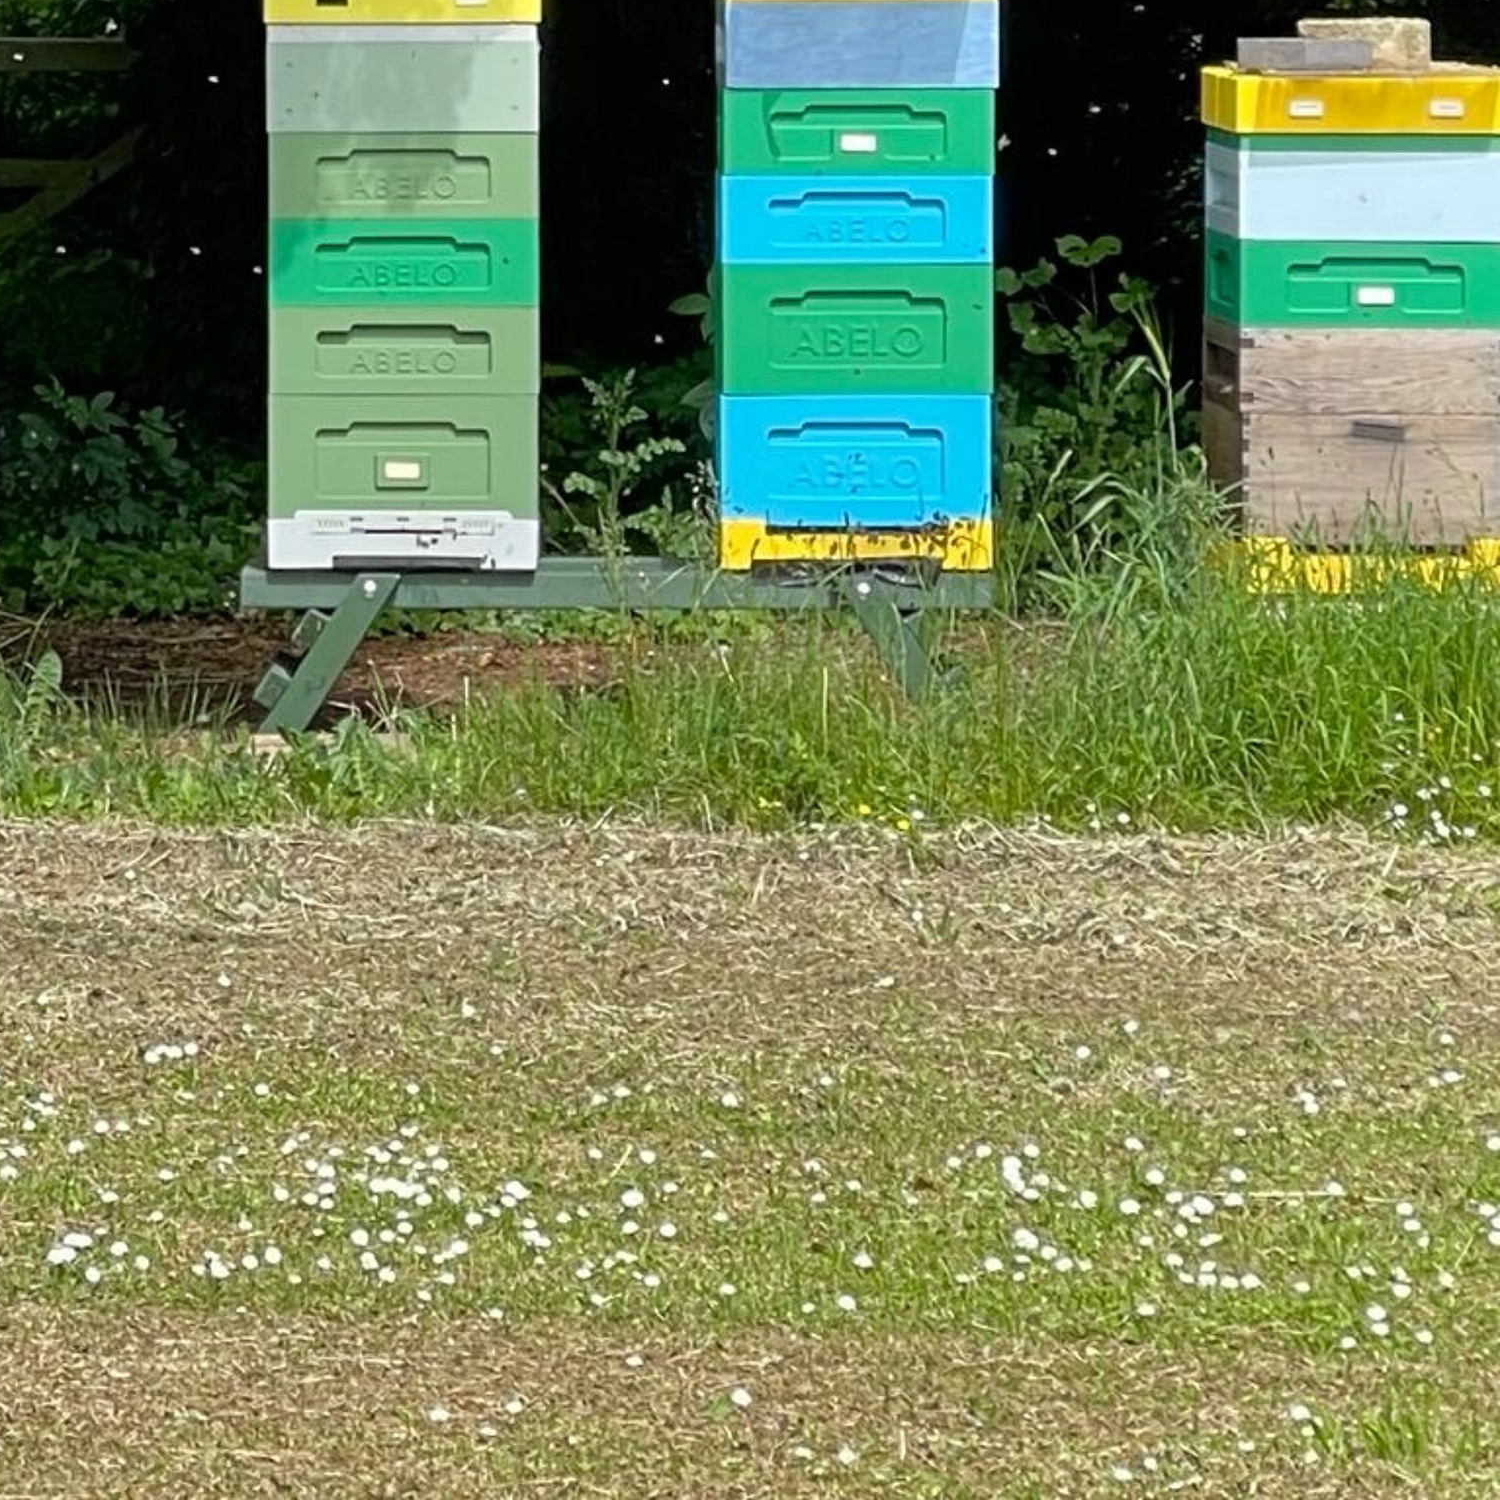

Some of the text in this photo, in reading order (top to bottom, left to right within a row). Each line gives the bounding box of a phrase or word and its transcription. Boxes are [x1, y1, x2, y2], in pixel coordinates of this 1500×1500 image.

[349, 175, 457, 201] ABELO
[802, 218, 910, 244] ABELO
[348, 262, 457, 288] ABELO
[791, 324, 925, 360] ABELO
[350, 349, 457, 375] ABELO
[794, 454, 921, 490] ABELO
